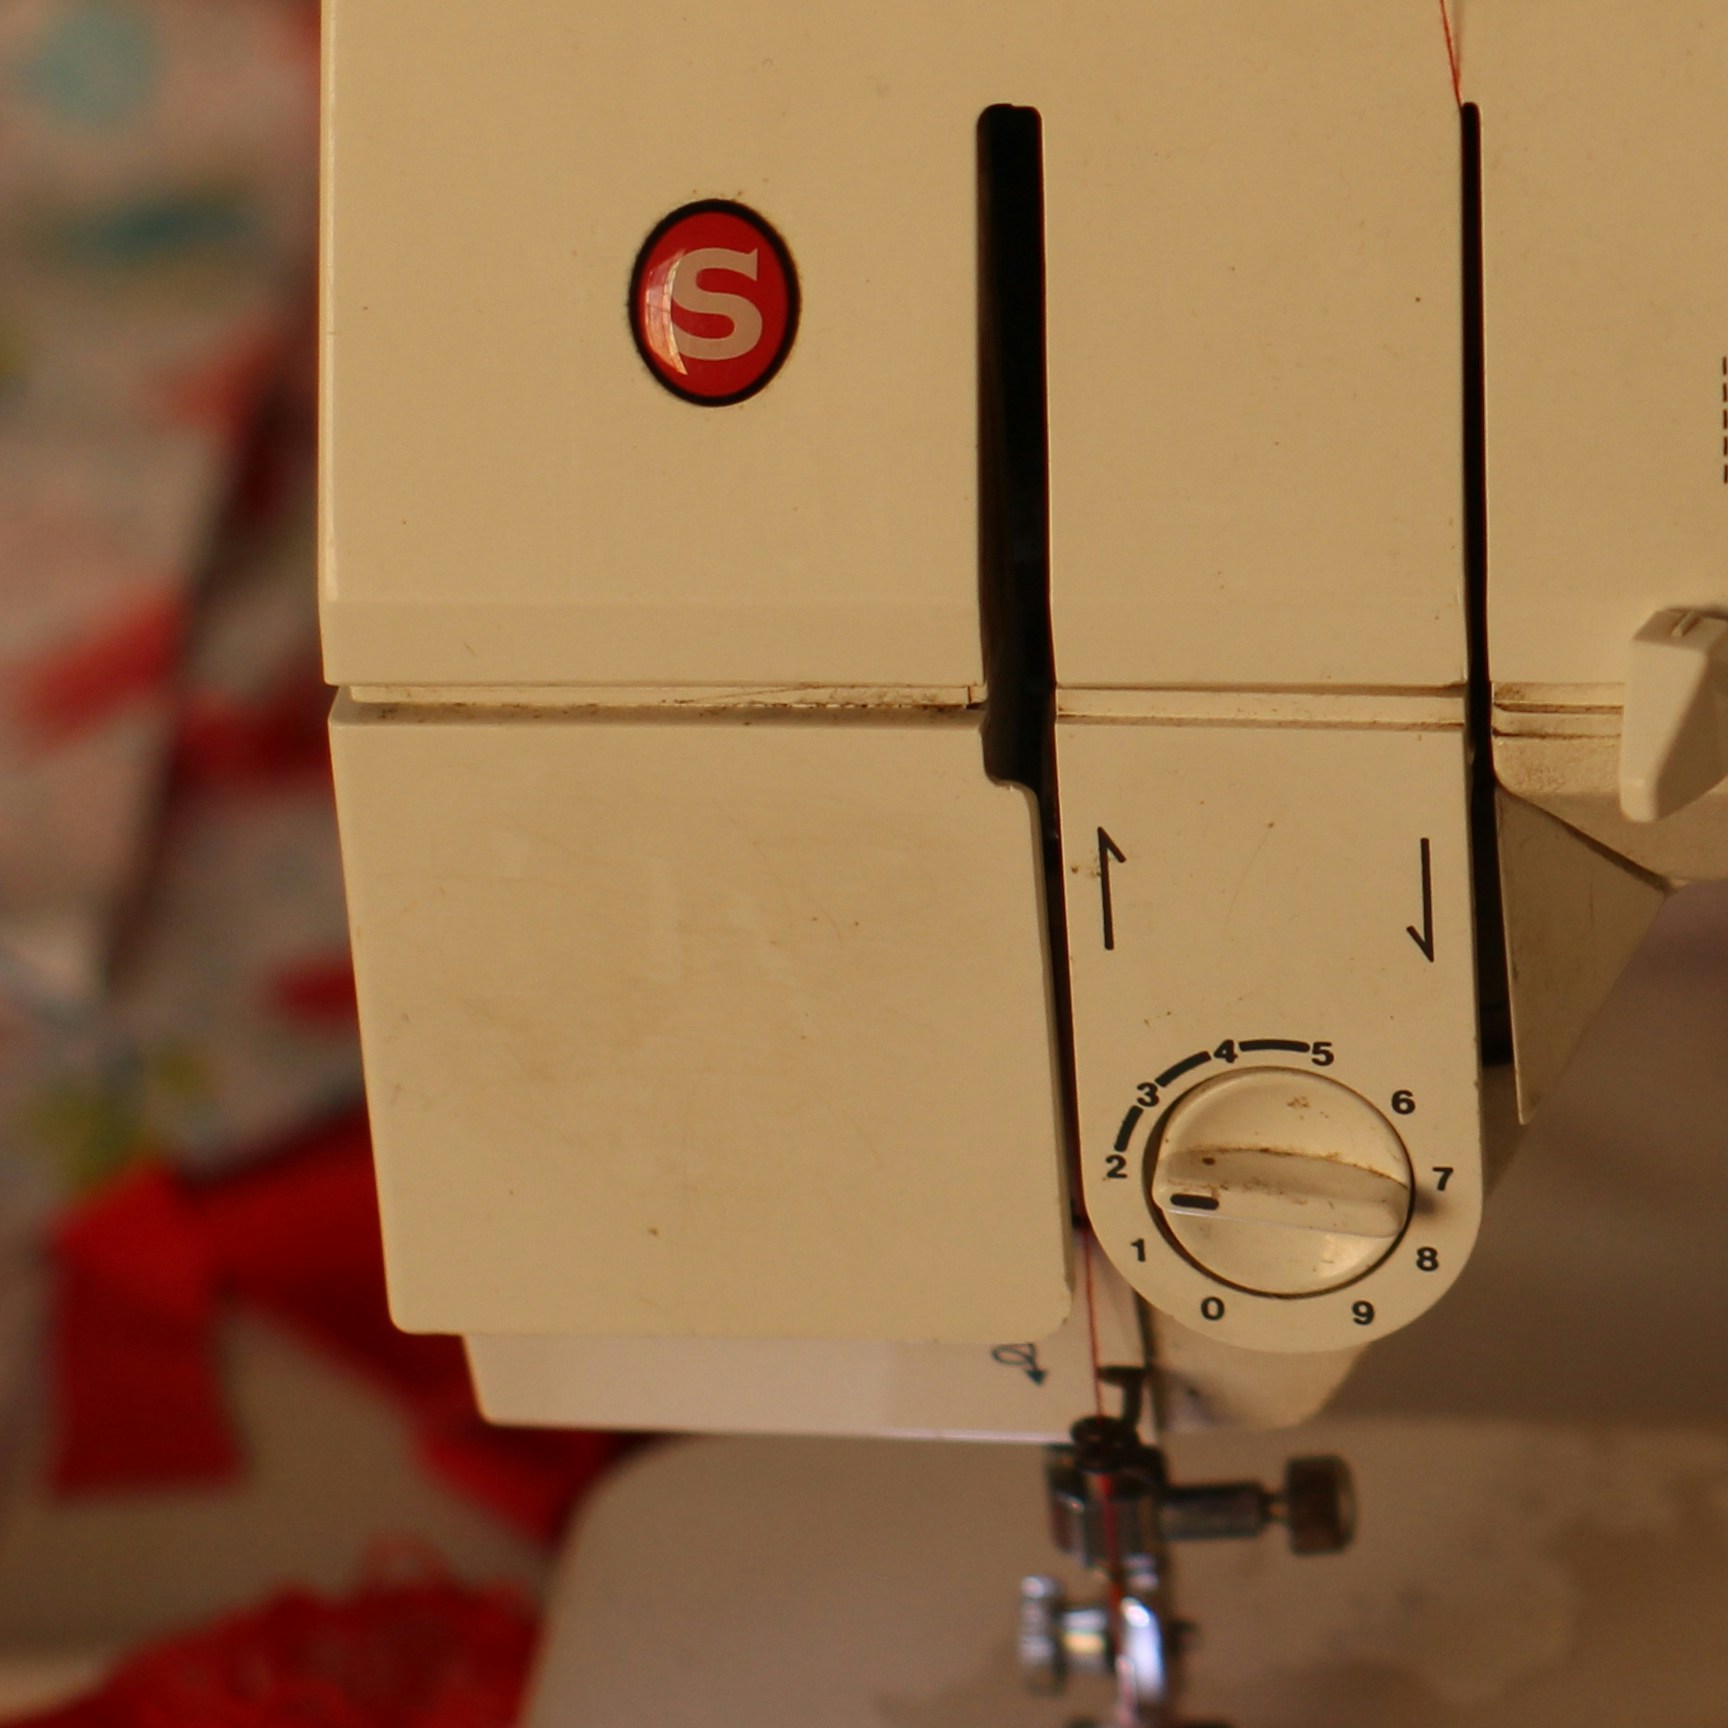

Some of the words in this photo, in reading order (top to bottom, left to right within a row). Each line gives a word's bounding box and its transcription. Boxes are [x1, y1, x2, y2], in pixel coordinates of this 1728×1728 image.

[670, 247, 763, 362] S
[1212, 1038, 1239, 1064] 4
[1311, 1041, 1335, 1067] 5
[1137, 1083, 1161, 1108] 3
[1390, 1089, 1416, 1115] 6
[1105, 1154, 1128, 1179] 2
[1431, 1166, 1455, 1192] 7
[1130, 1238, 1146, 1263] 1
[1415, 1246, 1440, 1272] 8
[1200, 1296, 1226, 1321] 0
[1351, 1300, 1376, 1326] 9
